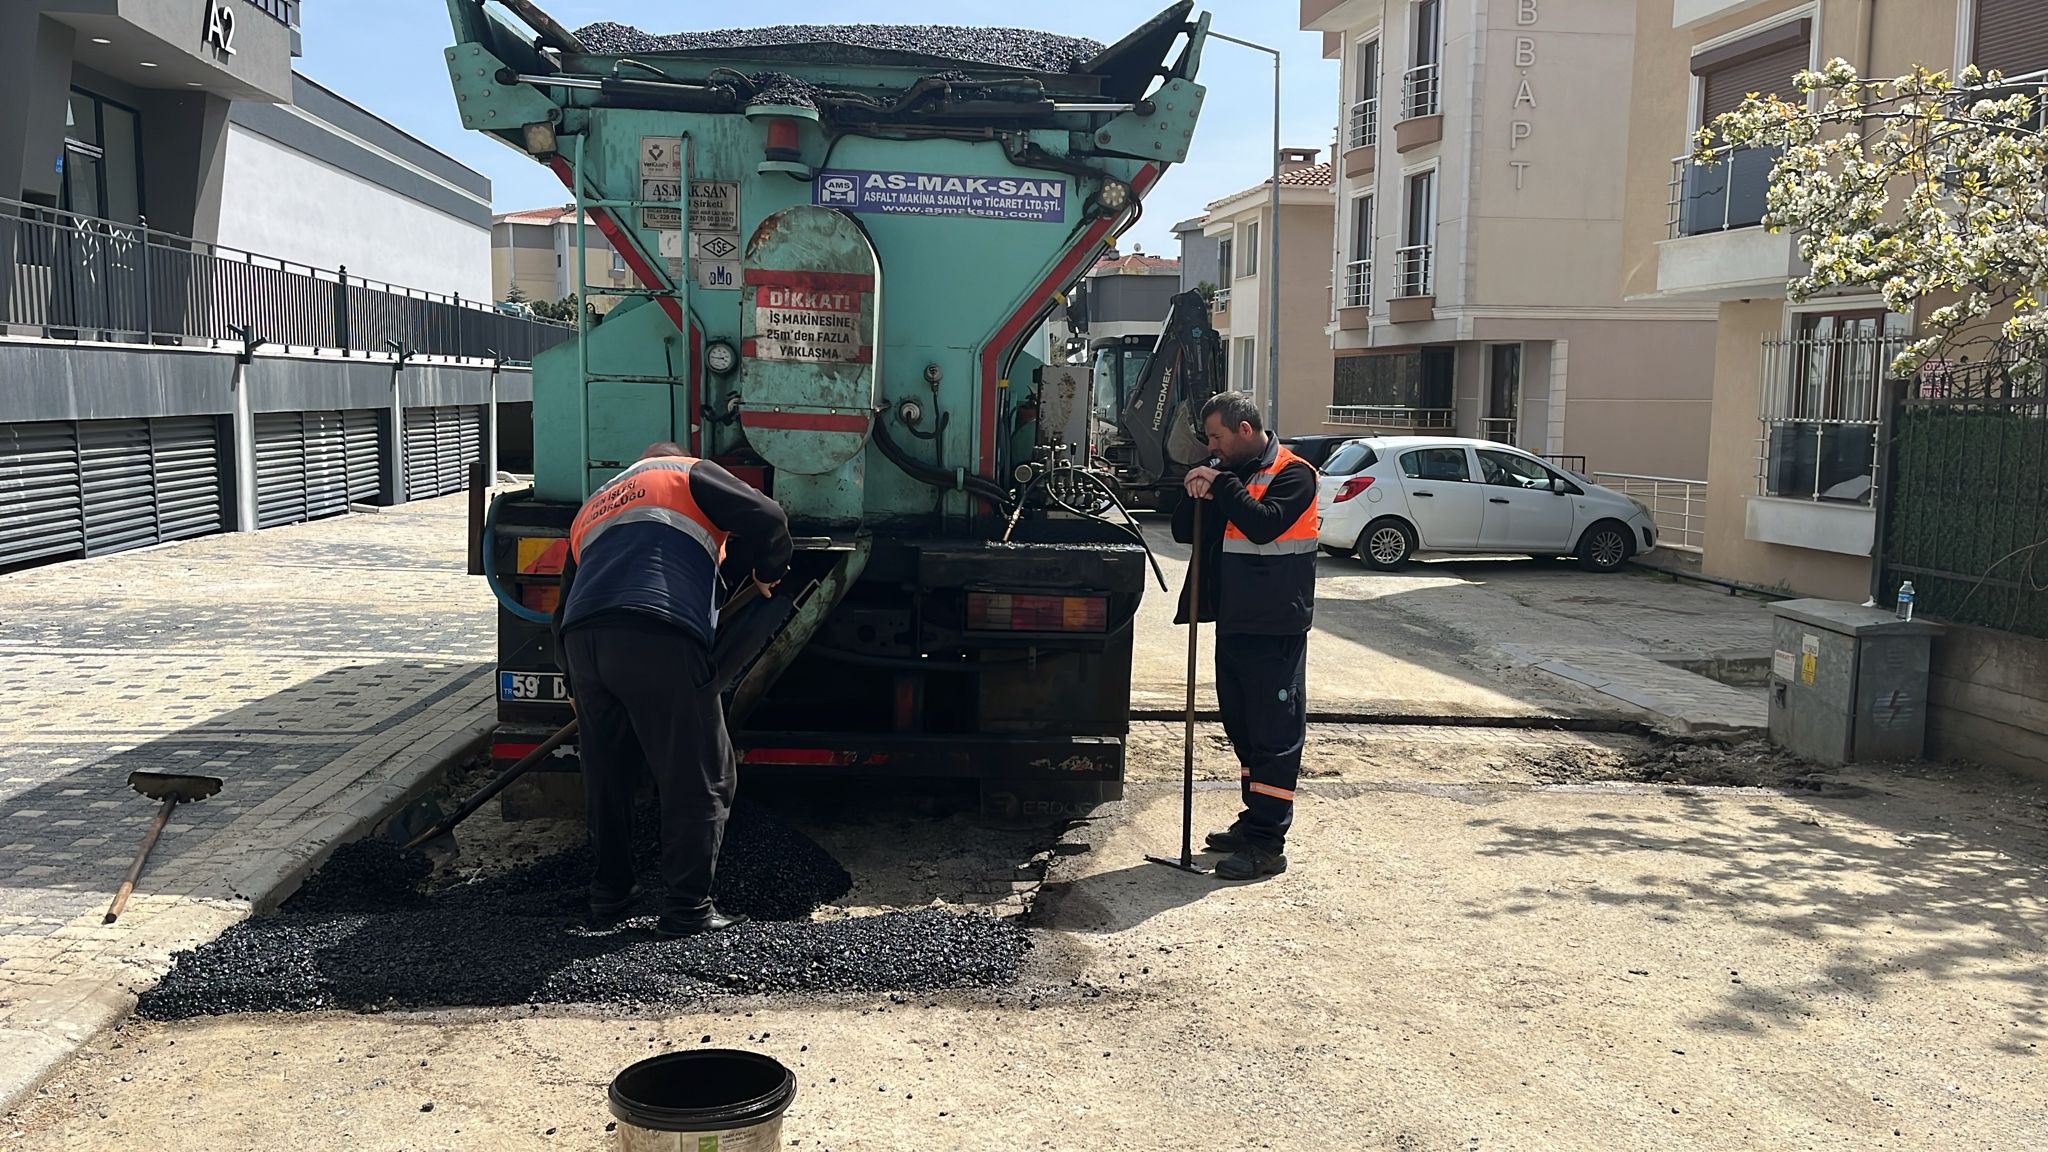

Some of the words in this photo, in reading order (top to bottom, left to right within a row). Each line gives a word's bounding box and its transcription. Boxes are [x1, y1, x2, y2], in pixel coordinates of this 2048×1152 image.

[207, 0, 237, 56] A2
[652, 184, 728, 198] AS.MK.SAN
[828, 182, 852, 190] AMS
[864, 174, 1062, 197] AS-MAK-SAN
[864, 191, 897, 203] ASFALT
[899, 193, 935, 205] MAKİNA
[937, 194, 970, 206] SANAYİ
[972, 198, 982, 207] ve
[985, 196, 1023, 209] TİCARET
[881, 204, 1043, 219] www.asmaksan.com
[711, 241, 727, 254] TSE
[770, 288, 850, 309] DİKKAT!
[769, 310, 780, 326] İŞ
[782, 311, 851, 328] MAKİNESİNE
[767, 329, 815, 342] 25m'den
[817, 331, 850, 344] FAZLA
[780, 346, 839, 361] YAKLAŞMA
[512, 675, 539, 698] 59
